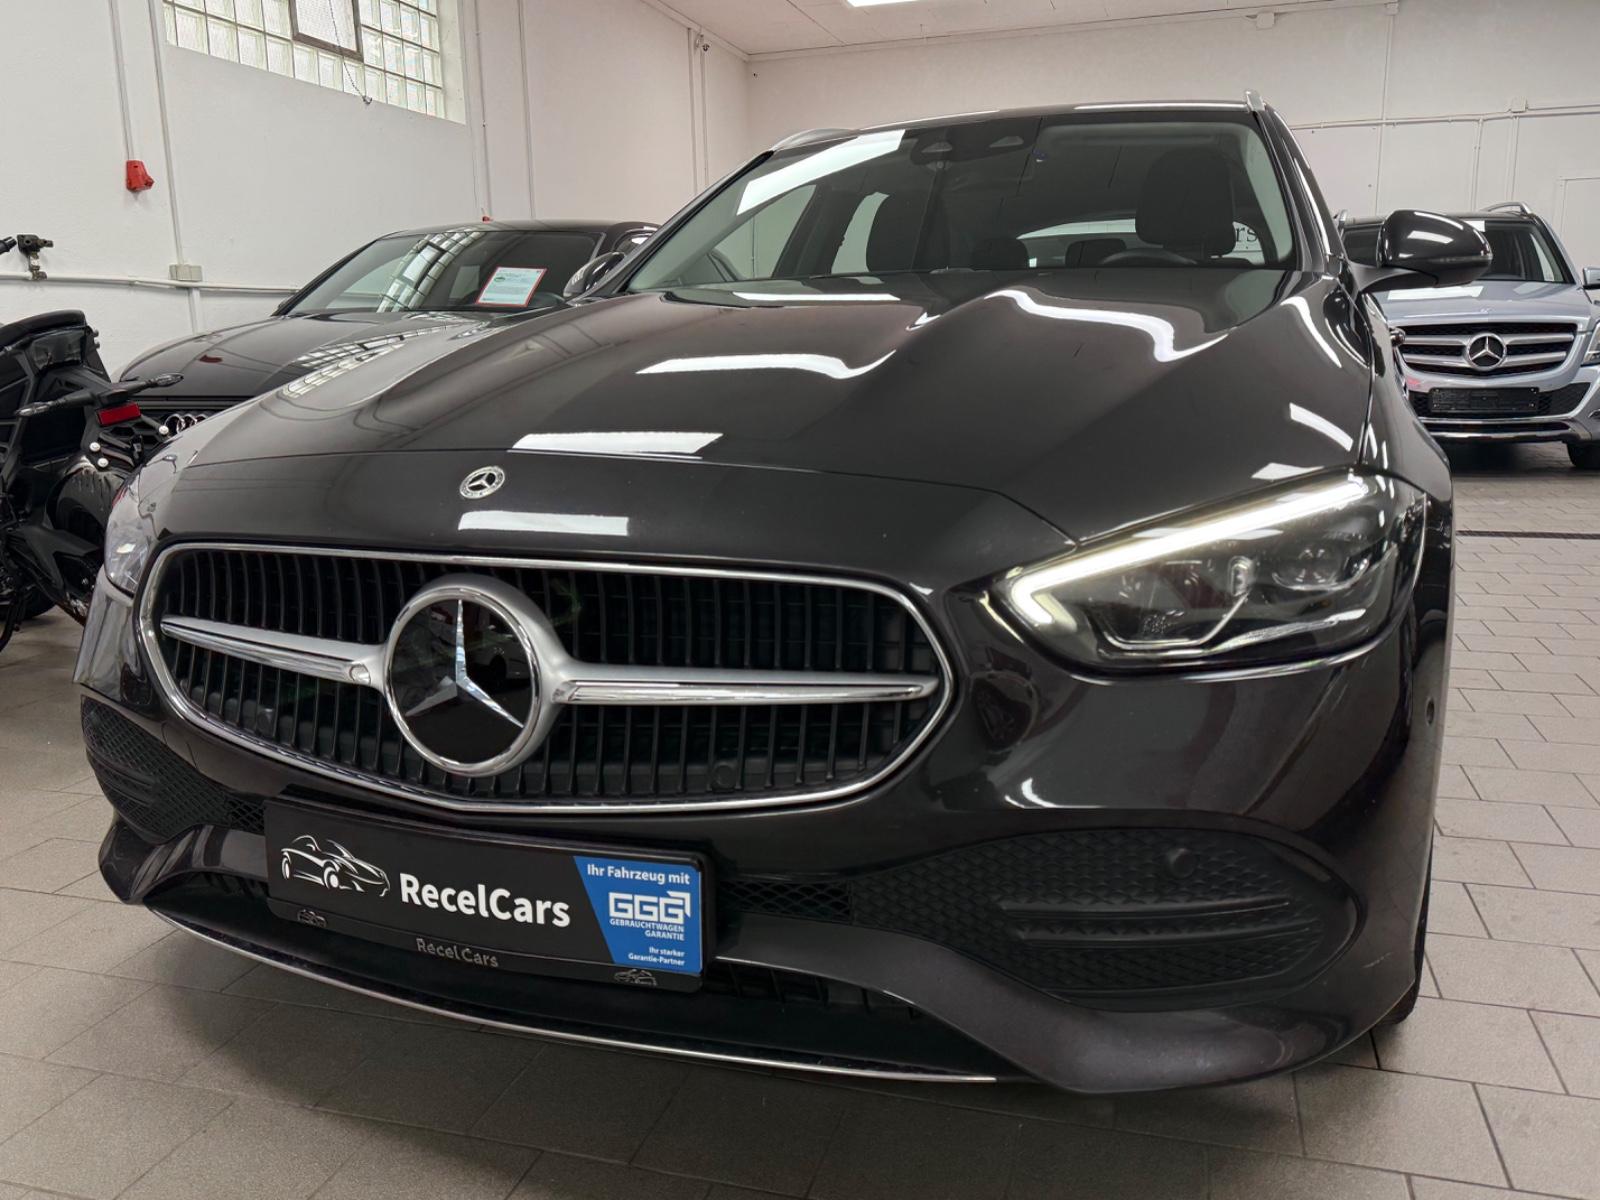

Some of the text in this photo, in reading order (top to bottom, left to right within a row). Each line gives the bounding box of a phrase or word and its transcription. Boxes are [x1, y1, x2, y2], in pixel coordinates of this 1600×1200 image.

[587, 864, 690, 885] Ihr Fahrzeug mit
[400, 873, 570, 927] RecelCars
[608, 890, 691, 924] GGG
[609, 918, 684, 933] GEBRAUCHTWAGEN
[644, 930, 685, 941] GARANTIE
[649, 946, 685, 957] Ihr starker
[628, 953, 685, 966] Garantie-Partner
